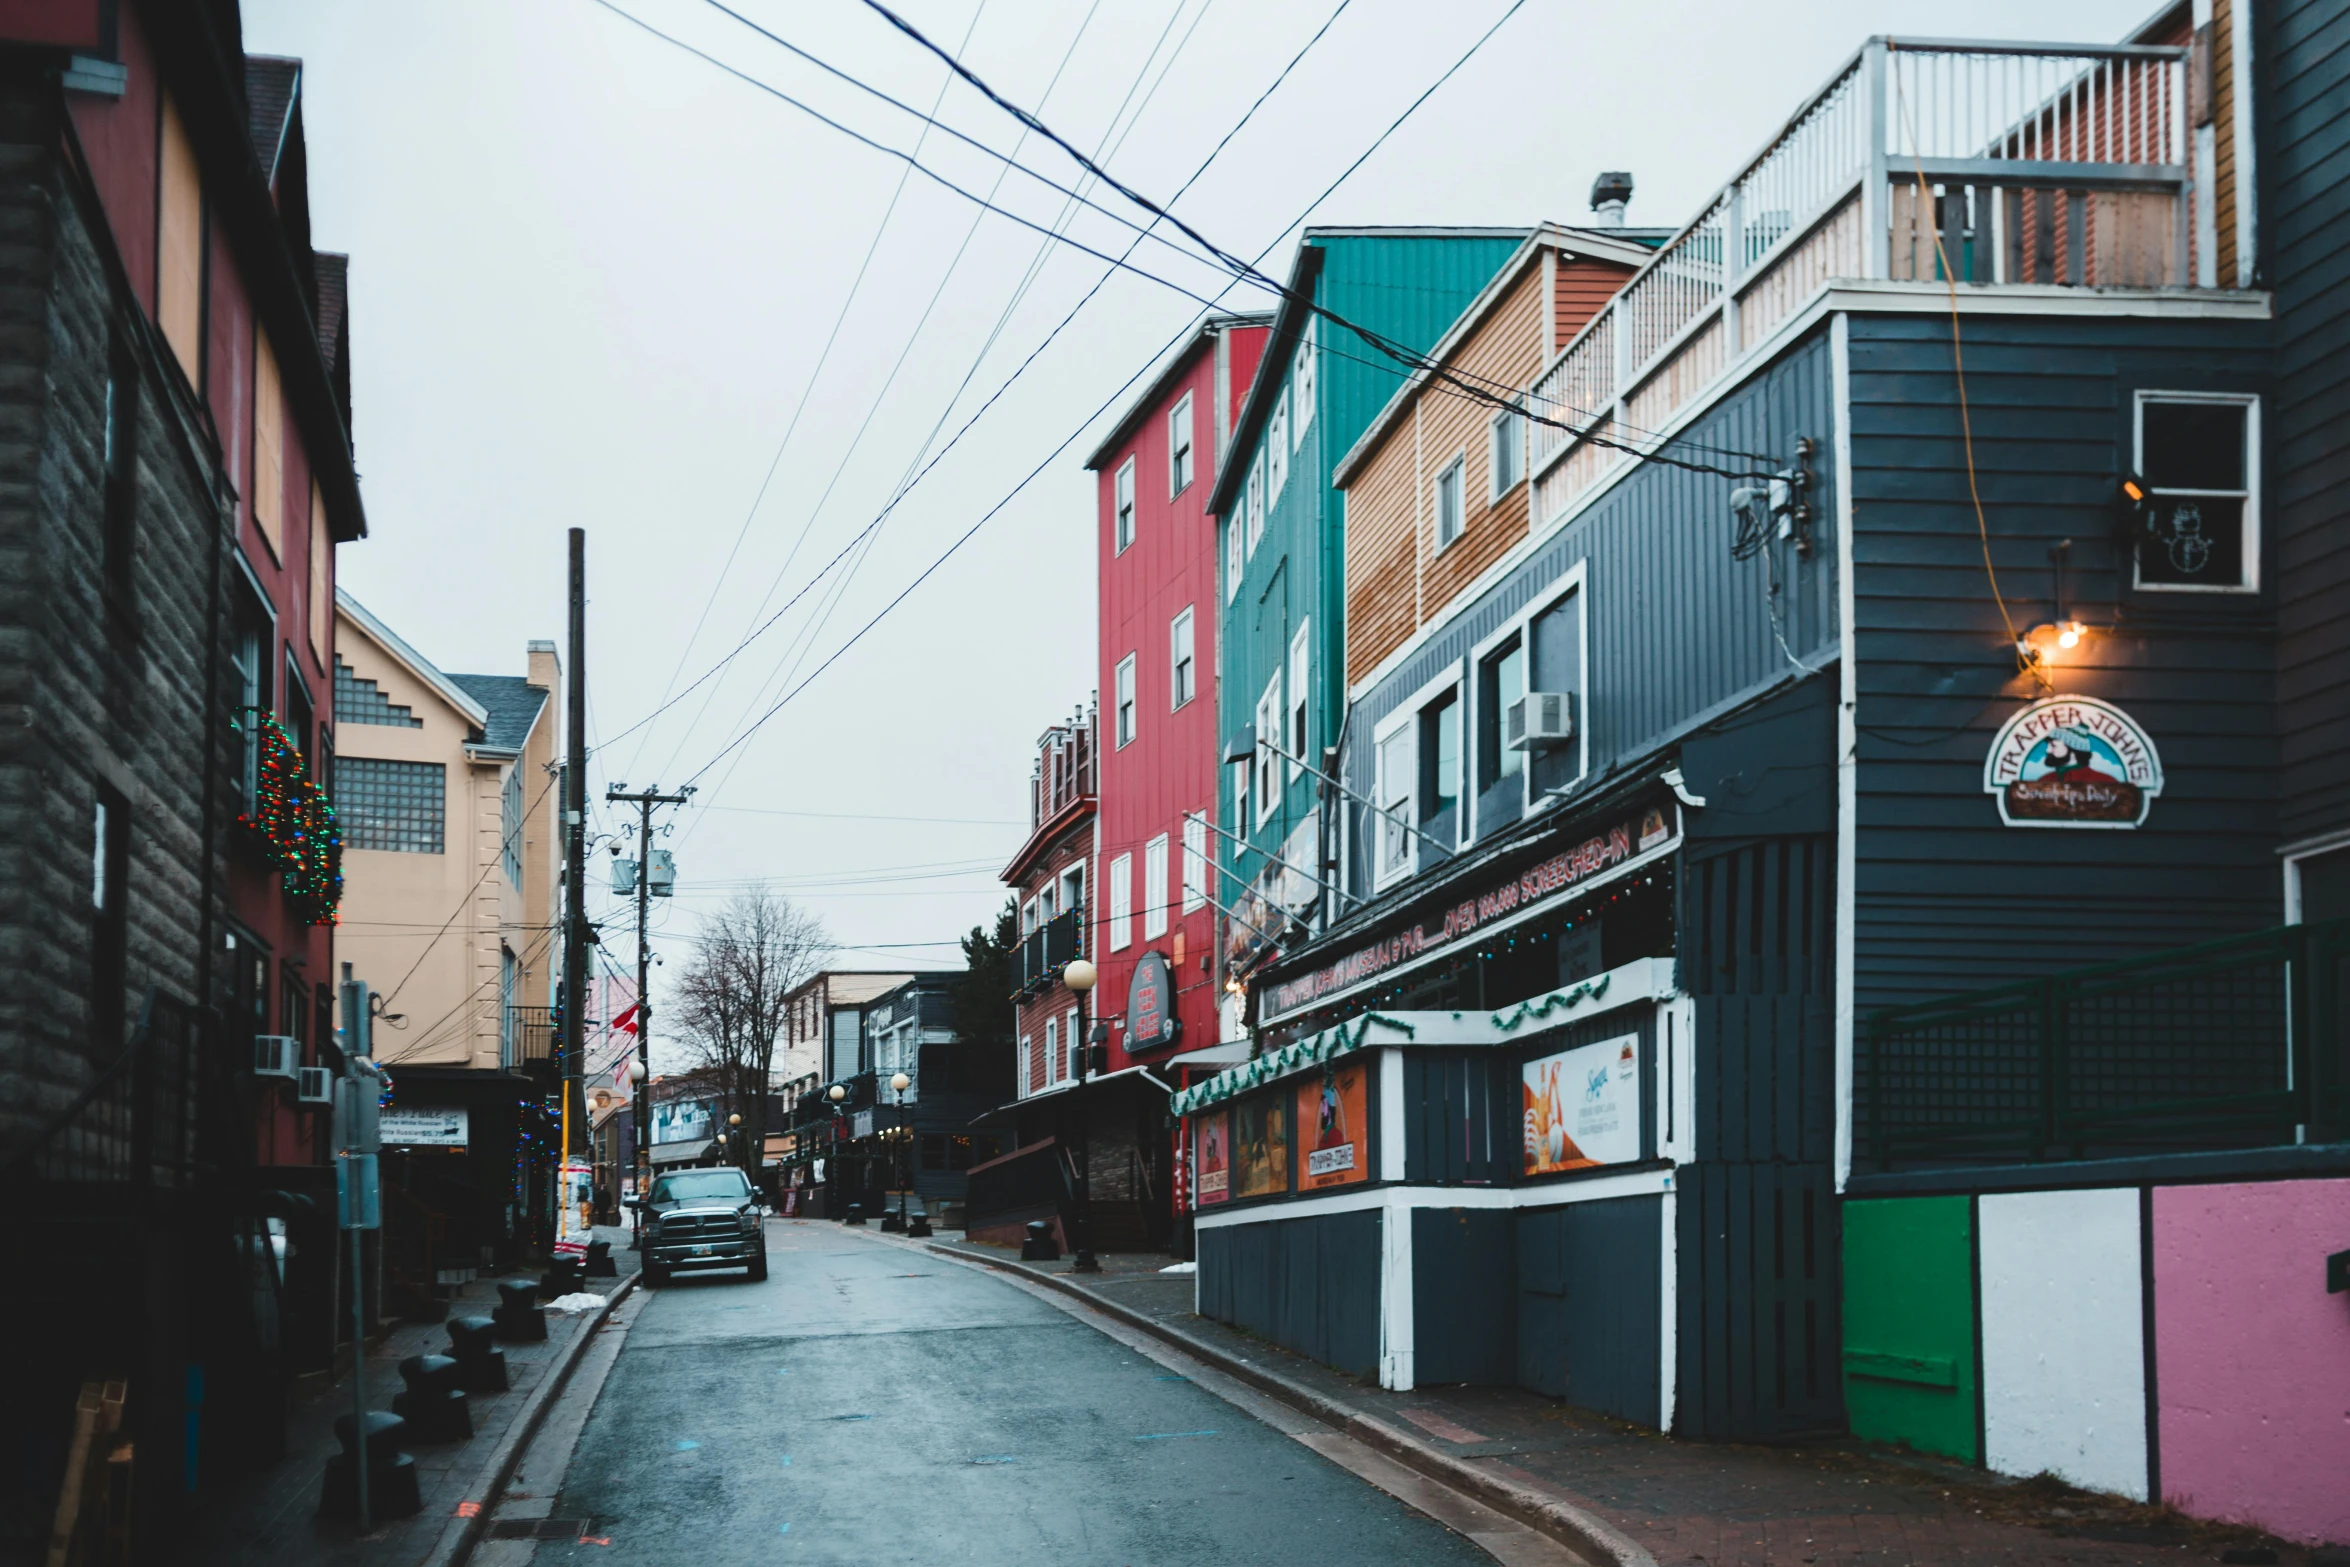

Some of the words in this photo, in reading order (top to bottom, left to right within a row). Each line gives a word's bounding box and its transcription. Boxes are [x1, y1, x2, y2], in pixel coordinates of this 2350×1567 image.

[1999, 707, 2083, 779] TRAPPER
[1344, 938, 1391, 982] MUSEUM
[1478, 883, 1519, 923] 100,000
[1520, 823, 1630, 903] SCREECHED-IN
